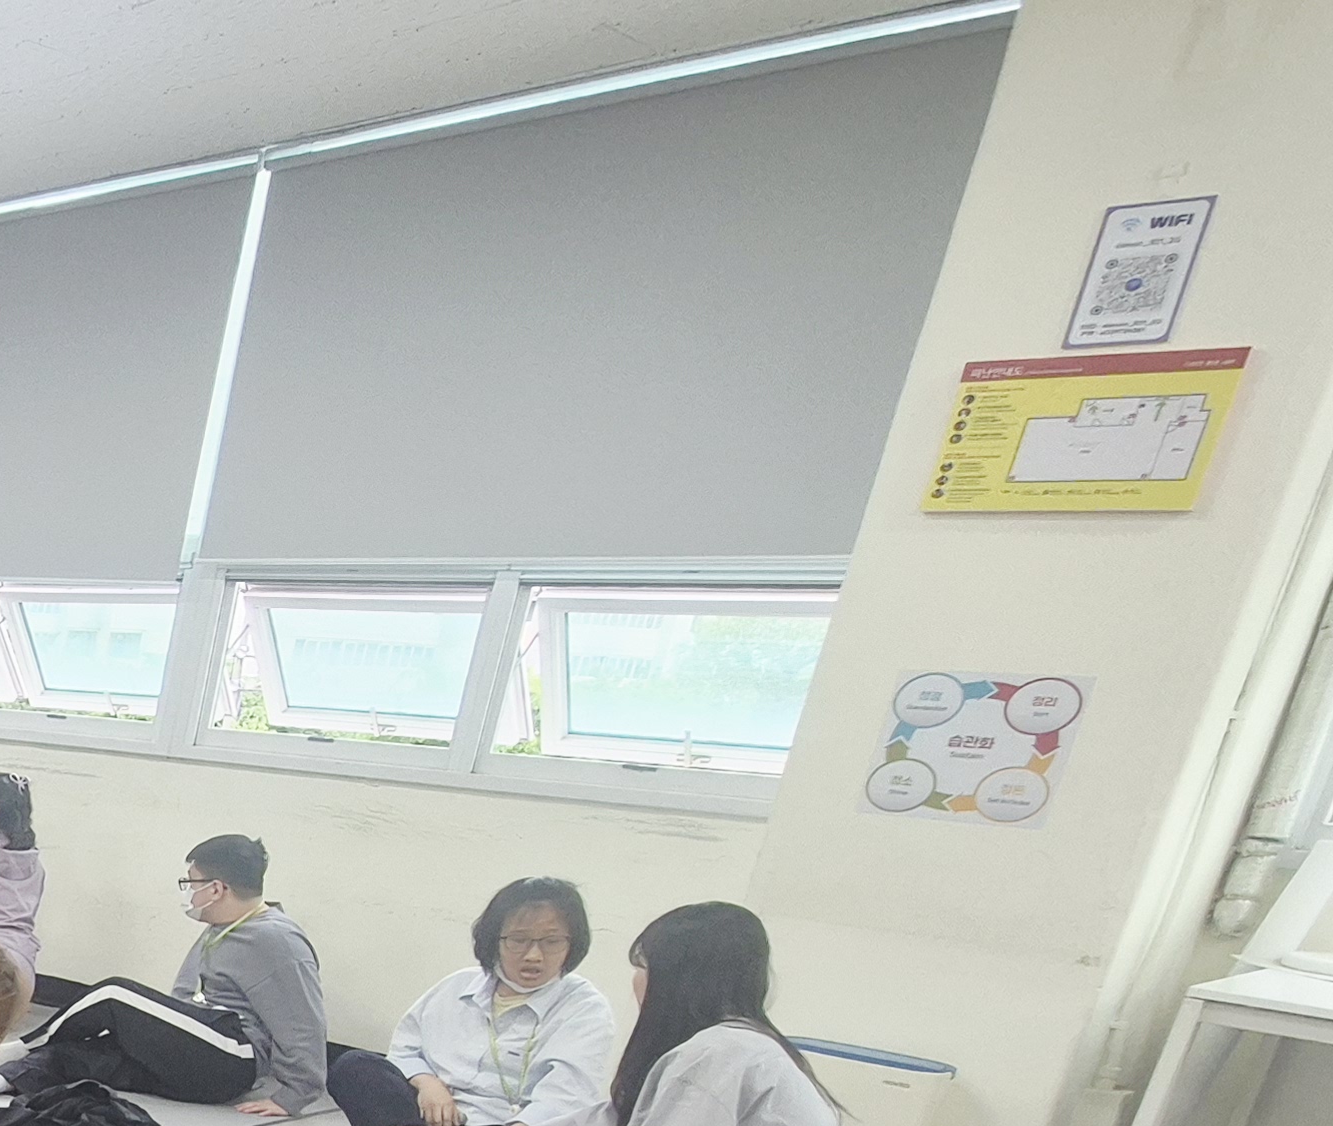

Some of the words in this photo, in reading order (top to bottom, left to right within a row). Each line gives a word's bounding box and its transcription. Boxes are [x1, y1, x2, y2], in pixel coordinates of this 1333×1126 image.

[1150, 213, 1195, 229] WIFI
[1032, 695, 1059, 707] 정리
[947, 734, 995, 750] 습관화
